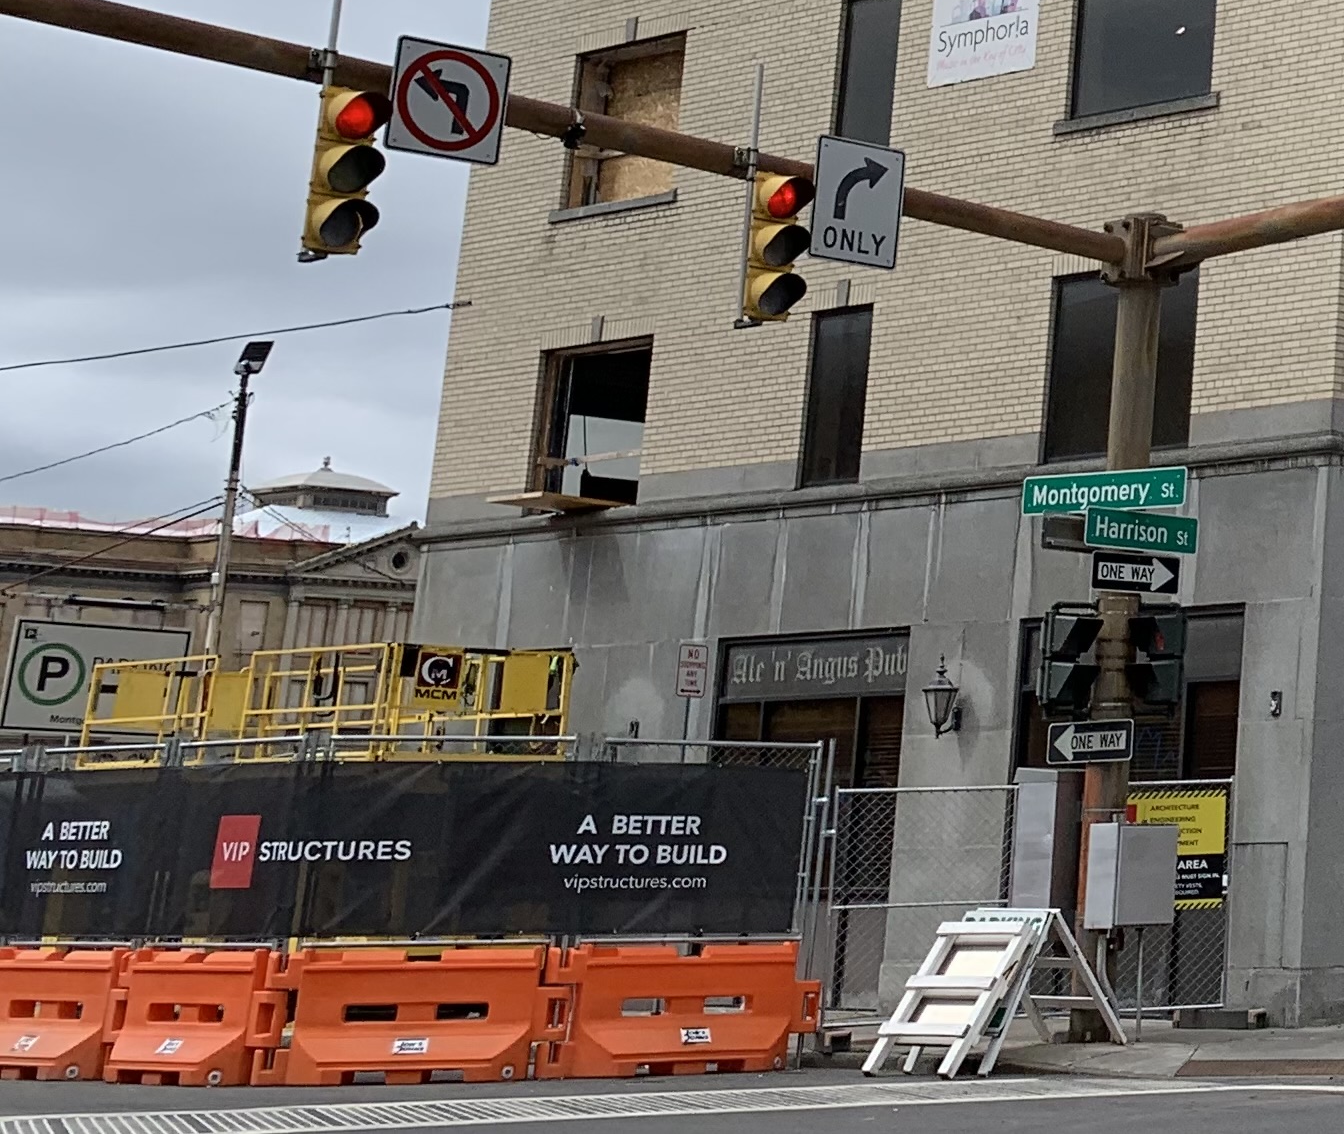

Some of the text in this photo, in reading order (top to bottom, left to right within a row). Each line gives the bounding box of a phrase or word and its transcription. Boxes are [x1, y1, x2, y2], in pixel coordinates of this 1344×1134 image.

[823, 225, 887, 257] ONLY
[1033, 482, 1150, 509] Montgomery
[1095, 515, 1188, 546] Harrison St
[1101, 564, 1156, 581] ONE WAY
[687, 648, 700, 659] NO
[730, 654, 765, 684] Ale
[794, 649, 859, 685] Angus
[863, 645, 907, 683] Pub
[415, 688, 457, 700] MCM
[1070, 733, 1123, 750] ONE WAY
[42, 820, 111, 841] A BETTER
[576, 814, 702, 835] A BETTER
[26, 849, 122, 869] WAY TO BUILD
[222, 840, 412, 862] VIP STRUCTURES
[550, 844, 728, 864] WAY TO BUILD
[1177, 859, 1208, 870] AREA
[30, 879, 107, 897] vipstructures.com
[563, 874, 707, 893] vipstructures.com
